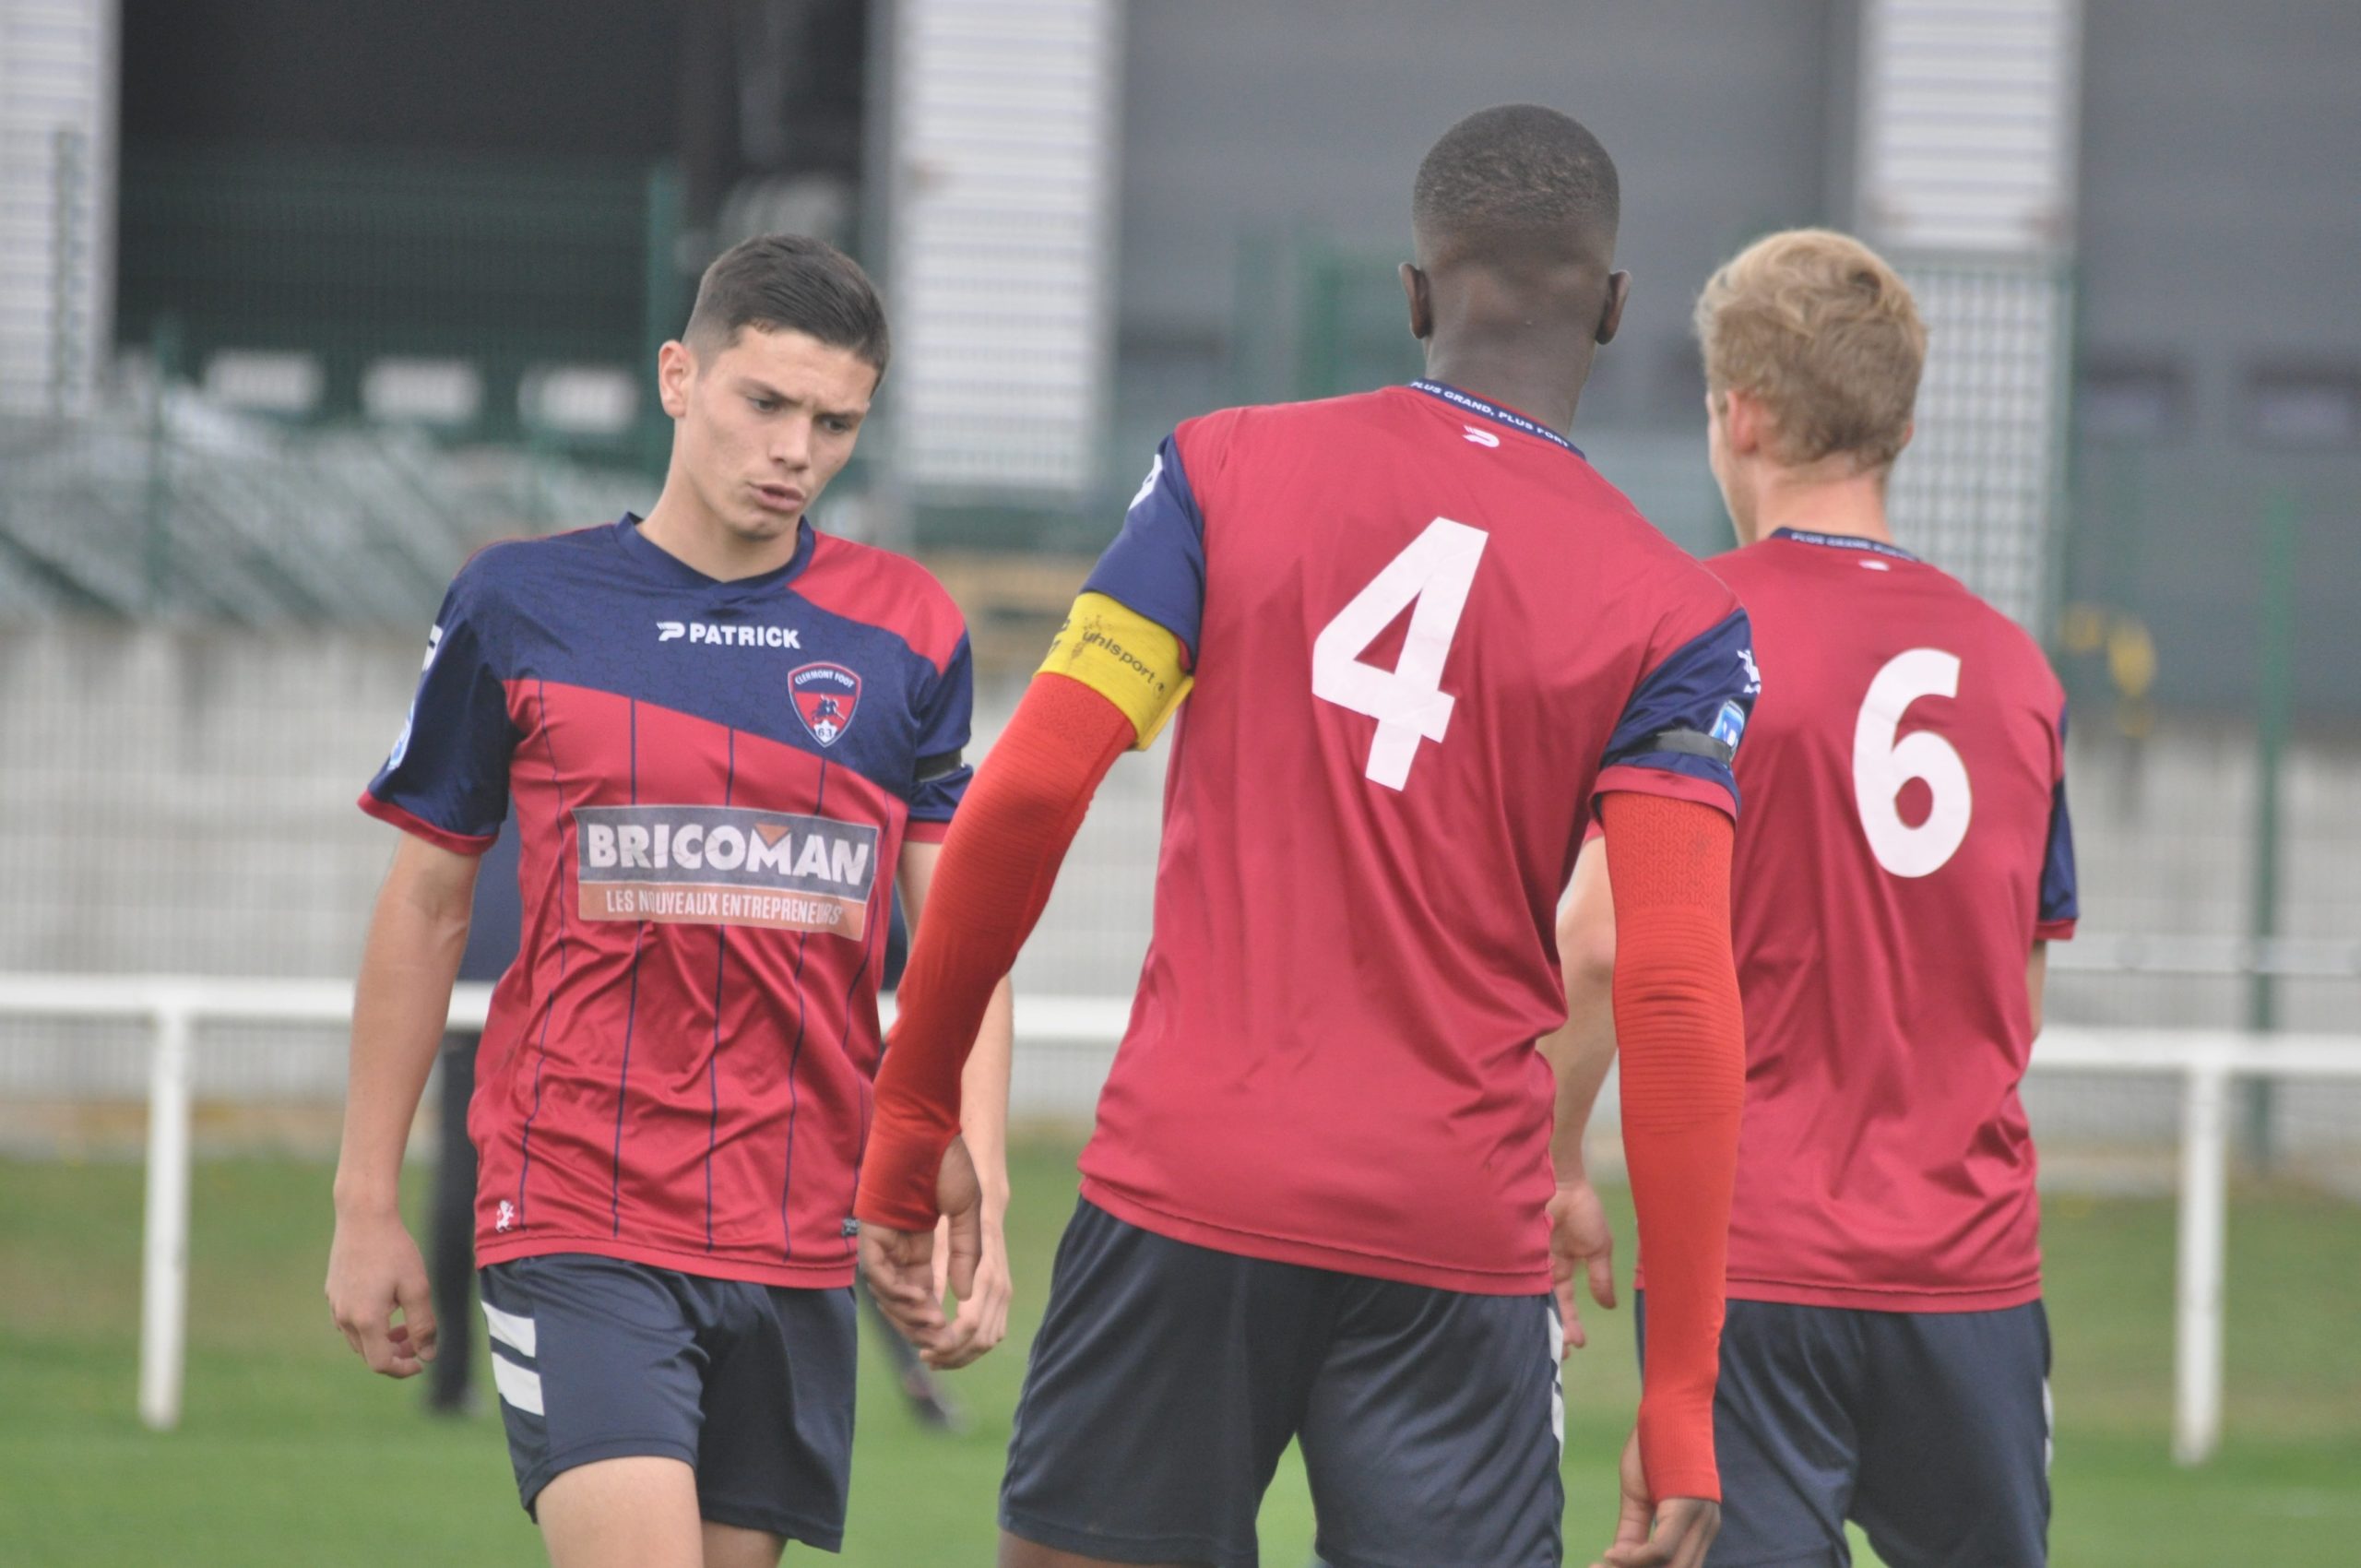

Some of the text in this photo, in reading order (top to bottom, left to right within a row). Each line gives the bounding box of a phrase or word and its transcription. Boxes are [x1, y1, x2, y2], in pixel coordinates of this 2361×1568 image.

[1410, 381, 1442, 394] PLUS
[1443, 391, 1495, 416] GRAND,
[1499, 411, 1534, 430] PLUS
[689, 623, 801, 649] PATRICK
[1082, 630, 1156, 684] uhlsport
[1311, 516, 1489, 791] 4
[795, 669, 854, 688] CLERMONT FOOT
[818, 728, 832, 737] 63
[1852, 647, 1972, 878] 6
[587, 824, 869, 886] BRICOMAN
[606, 889, 843, 926] LES NOUVEAUX ENTREPRENEURS
